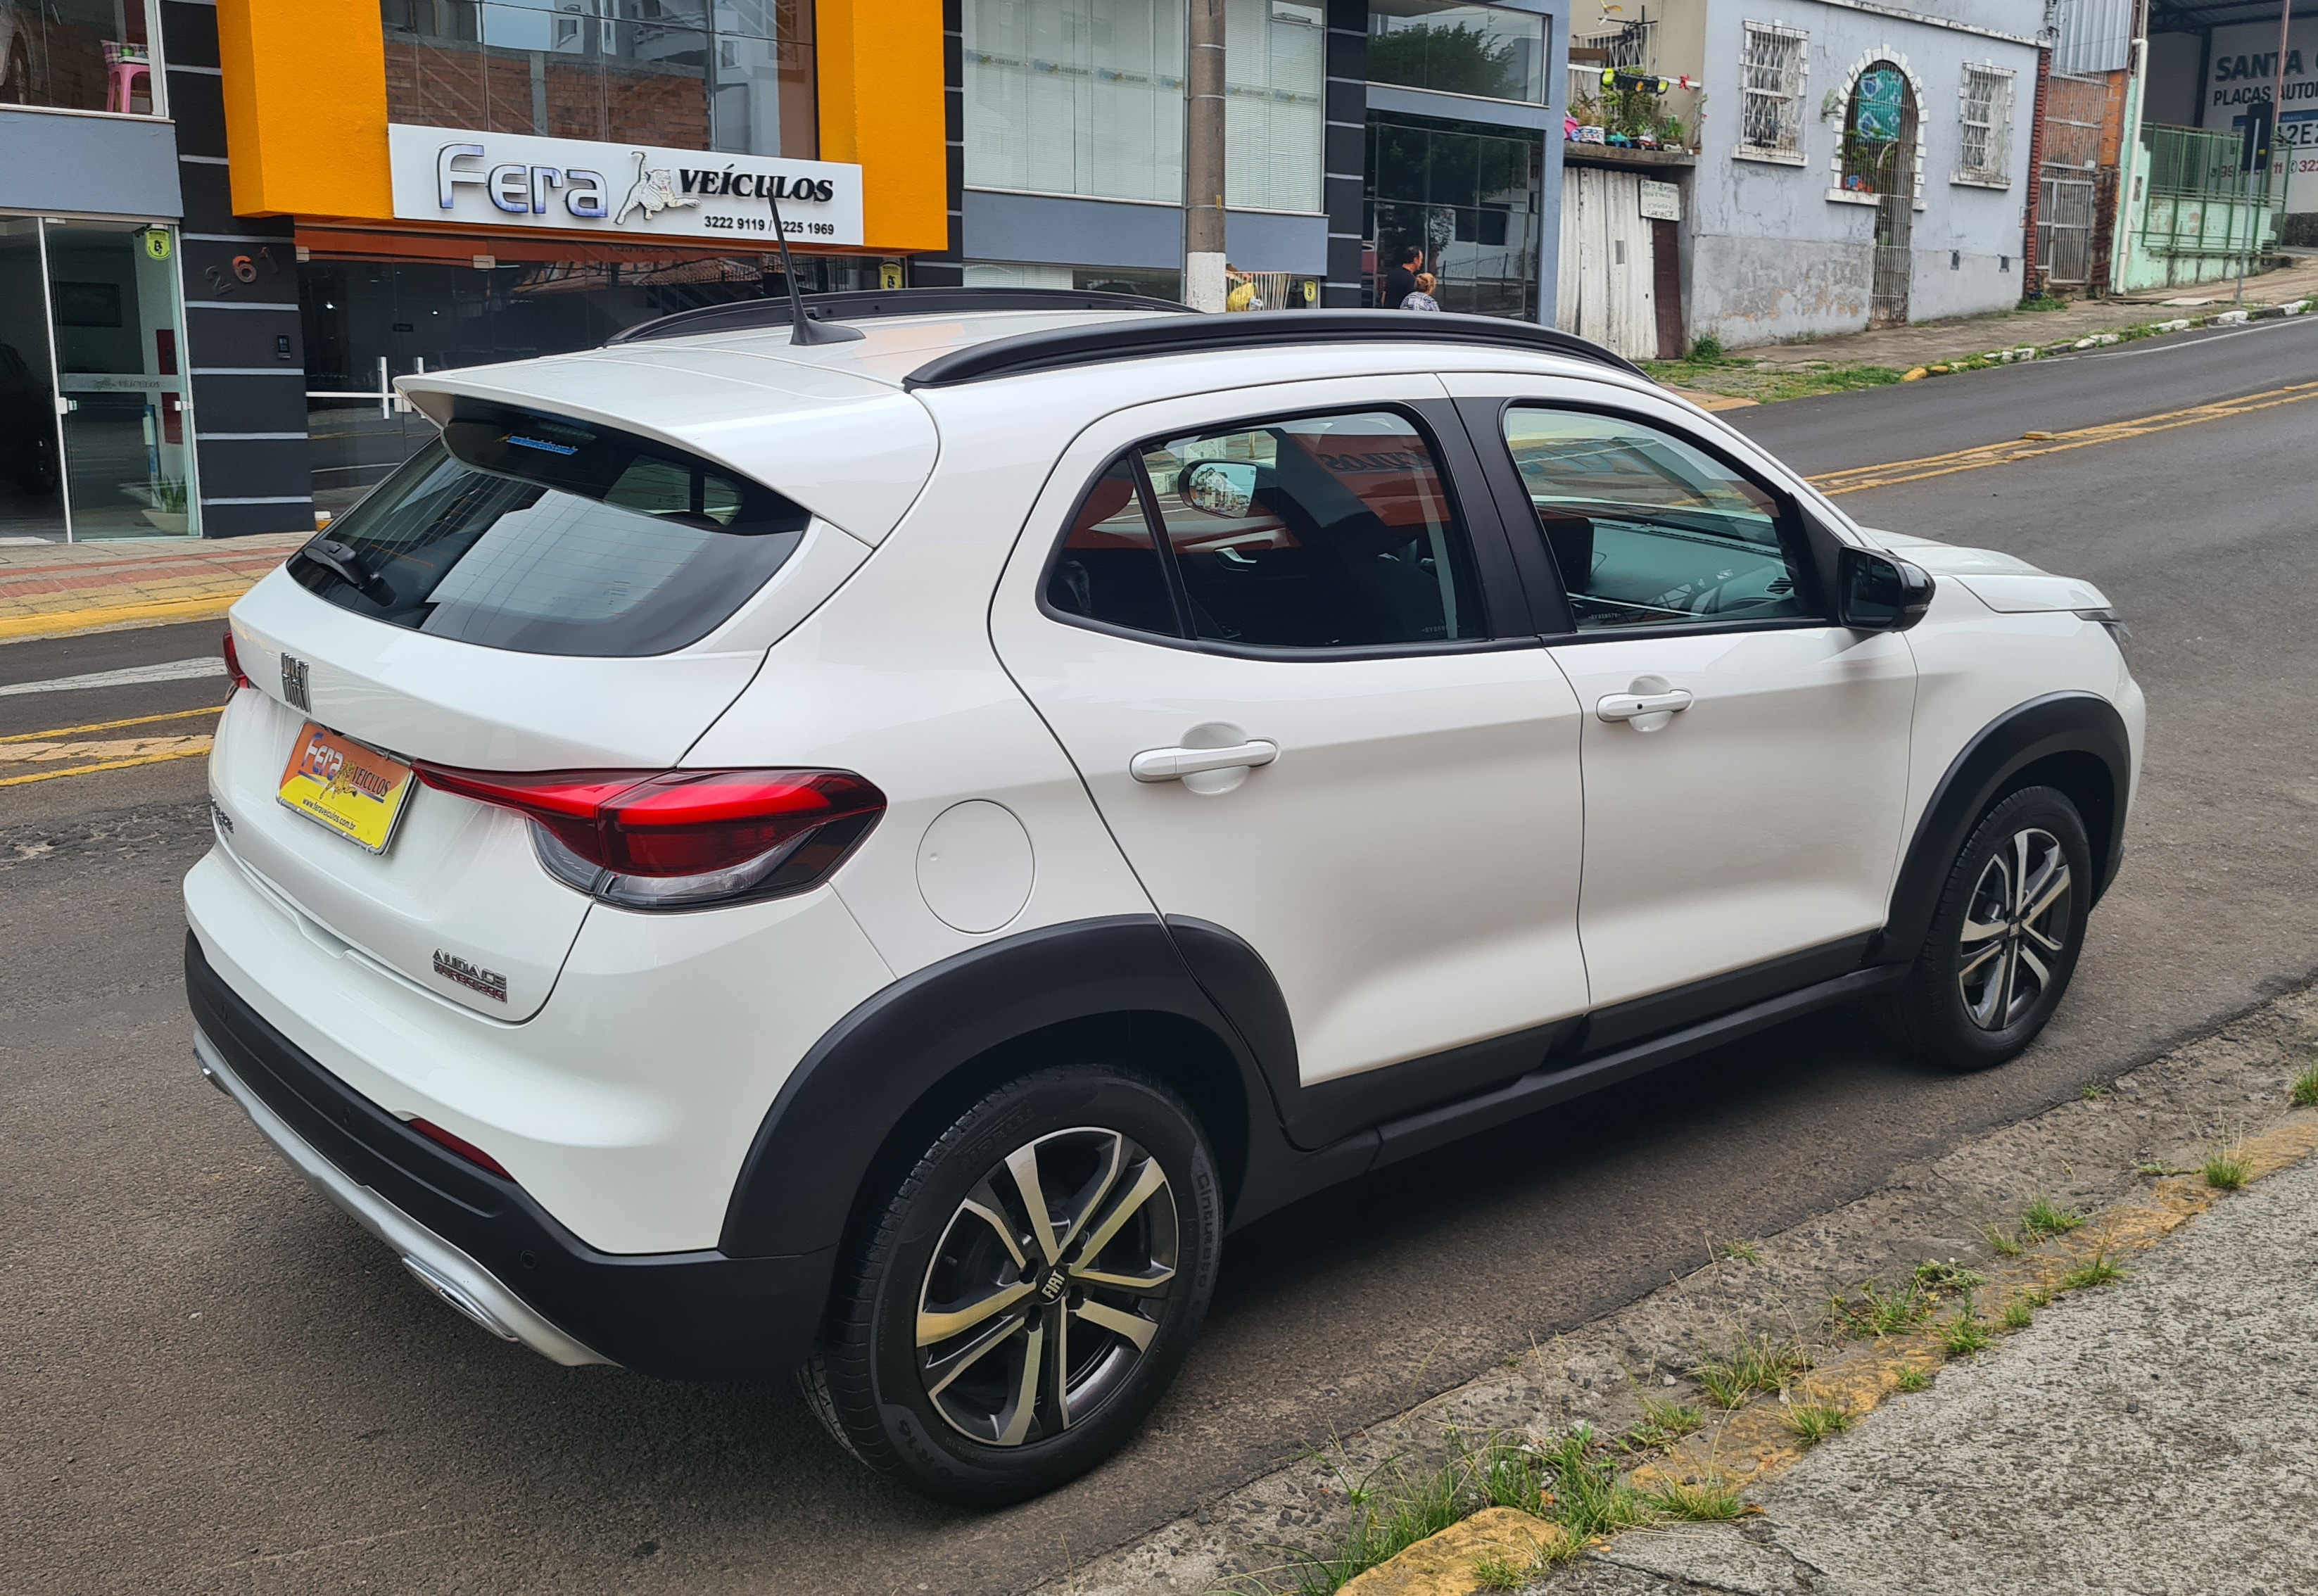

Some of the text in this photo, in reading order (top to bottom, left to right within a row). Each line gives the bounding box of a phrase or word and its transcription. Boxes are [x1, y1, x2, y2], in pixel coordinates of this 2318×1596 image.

[2215, 49, 2305, 82] SANTA
[2213, 85, 2272, 106] PLACAS
[437, 141, 609, 218] Fera
[679, 163, 834, 203] VEÍCULOS
[704, 215, 734, 229] 3222
[737, 217, 766, 231] 9119
[777, 220, 804, 234] 225
[807, 222, 835, 235] 1969
[301, 732, 344, 781] Fera
[352, 765, 391, 797] VEÍCULOS
[302, 797, 357, 831] www.feraveiculos.com.br
[432, 948, 507, 989] AUDACE
[1041, 1269, 1065, 1300] FIAT
